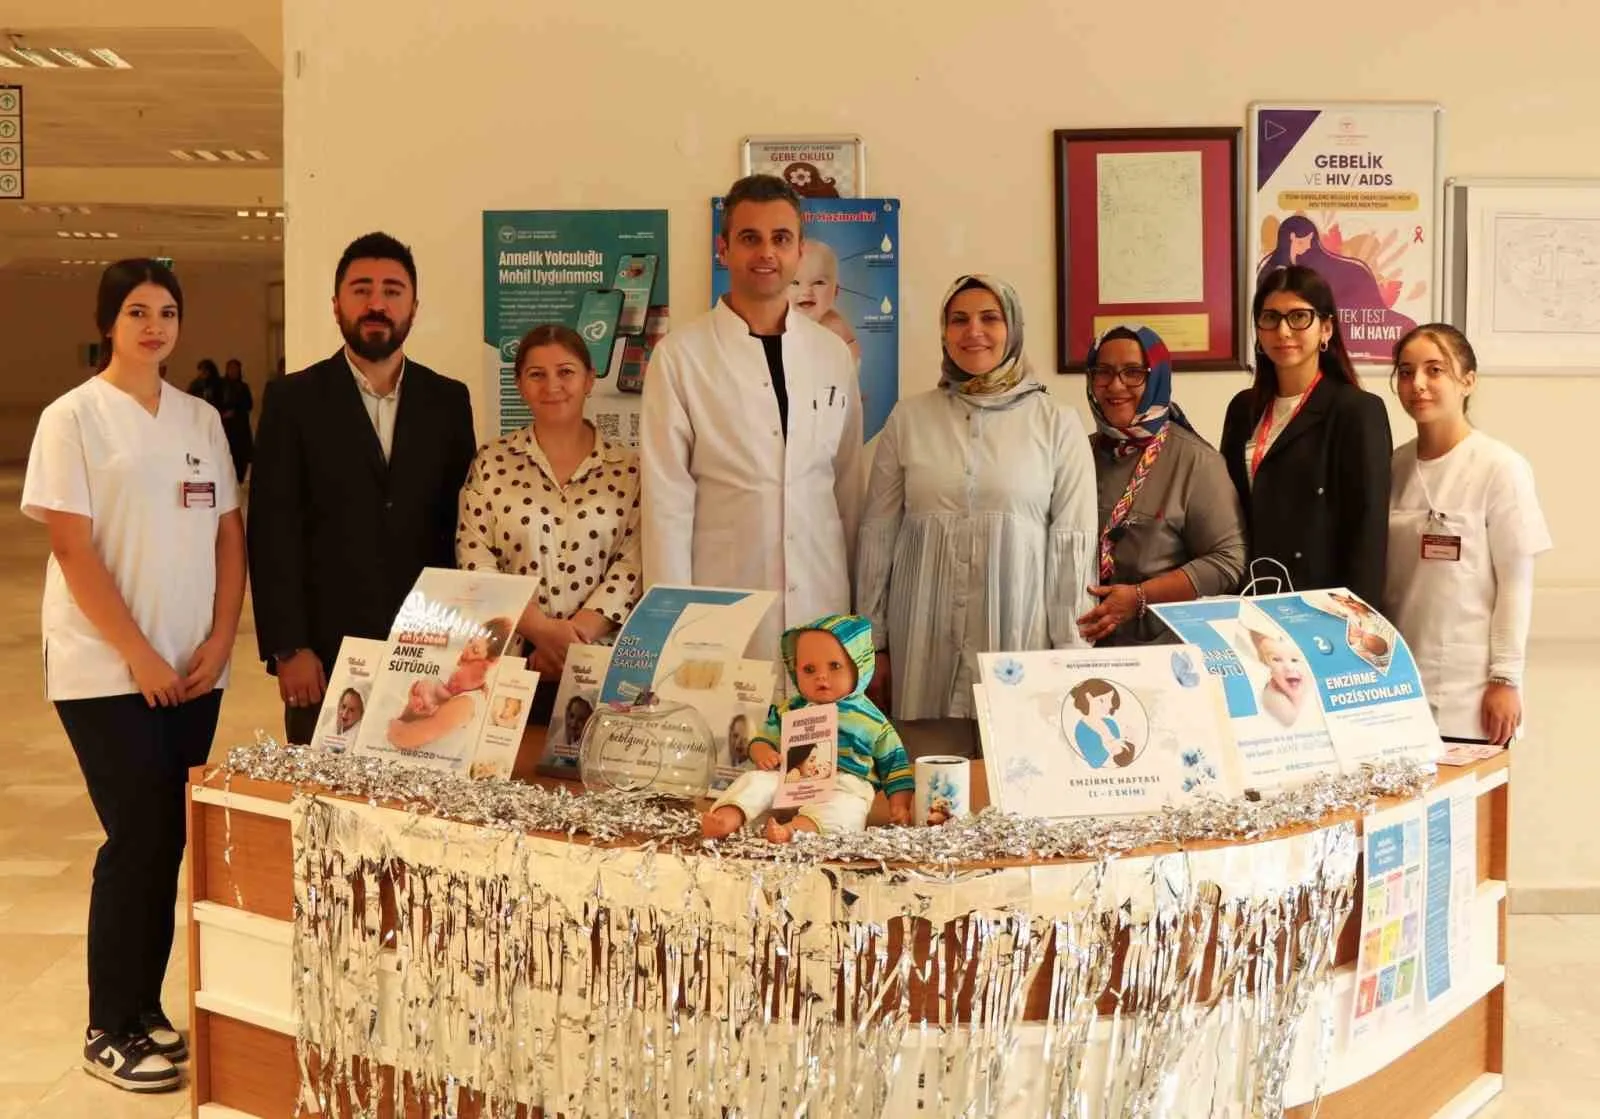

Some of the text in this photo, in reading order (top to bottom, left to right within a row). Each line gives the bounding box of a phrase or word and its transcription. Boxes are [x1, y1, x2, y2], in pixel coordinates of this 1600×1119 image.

[770, 151, 834, 161] GEBE OKULU
[1314, 152, 1383, 169] GEBELİK
[1304, 173, 1393, 186] VE HIV/AIDS
[499, 249, 603, 267] Annelik Yolculuğu
[499, 269, 604, 286] Mobil Uygulaması
[1337, 308, 1387, 324] TEK TEST
[1350, 324, 1402, 340] İKİ HAYAT
[1313, 636, 1329, 650] 2
[393, 646, 425, 659] ANNE
[388, 659, 441, 676] SÜTÜDÜR
[1326, 672, 1377, 690] EMZİRME
[1330, 683, 1413, 707] POZİSYONLARI
[1070, 776, 1160, 787] EMZİRME HAFTASI
